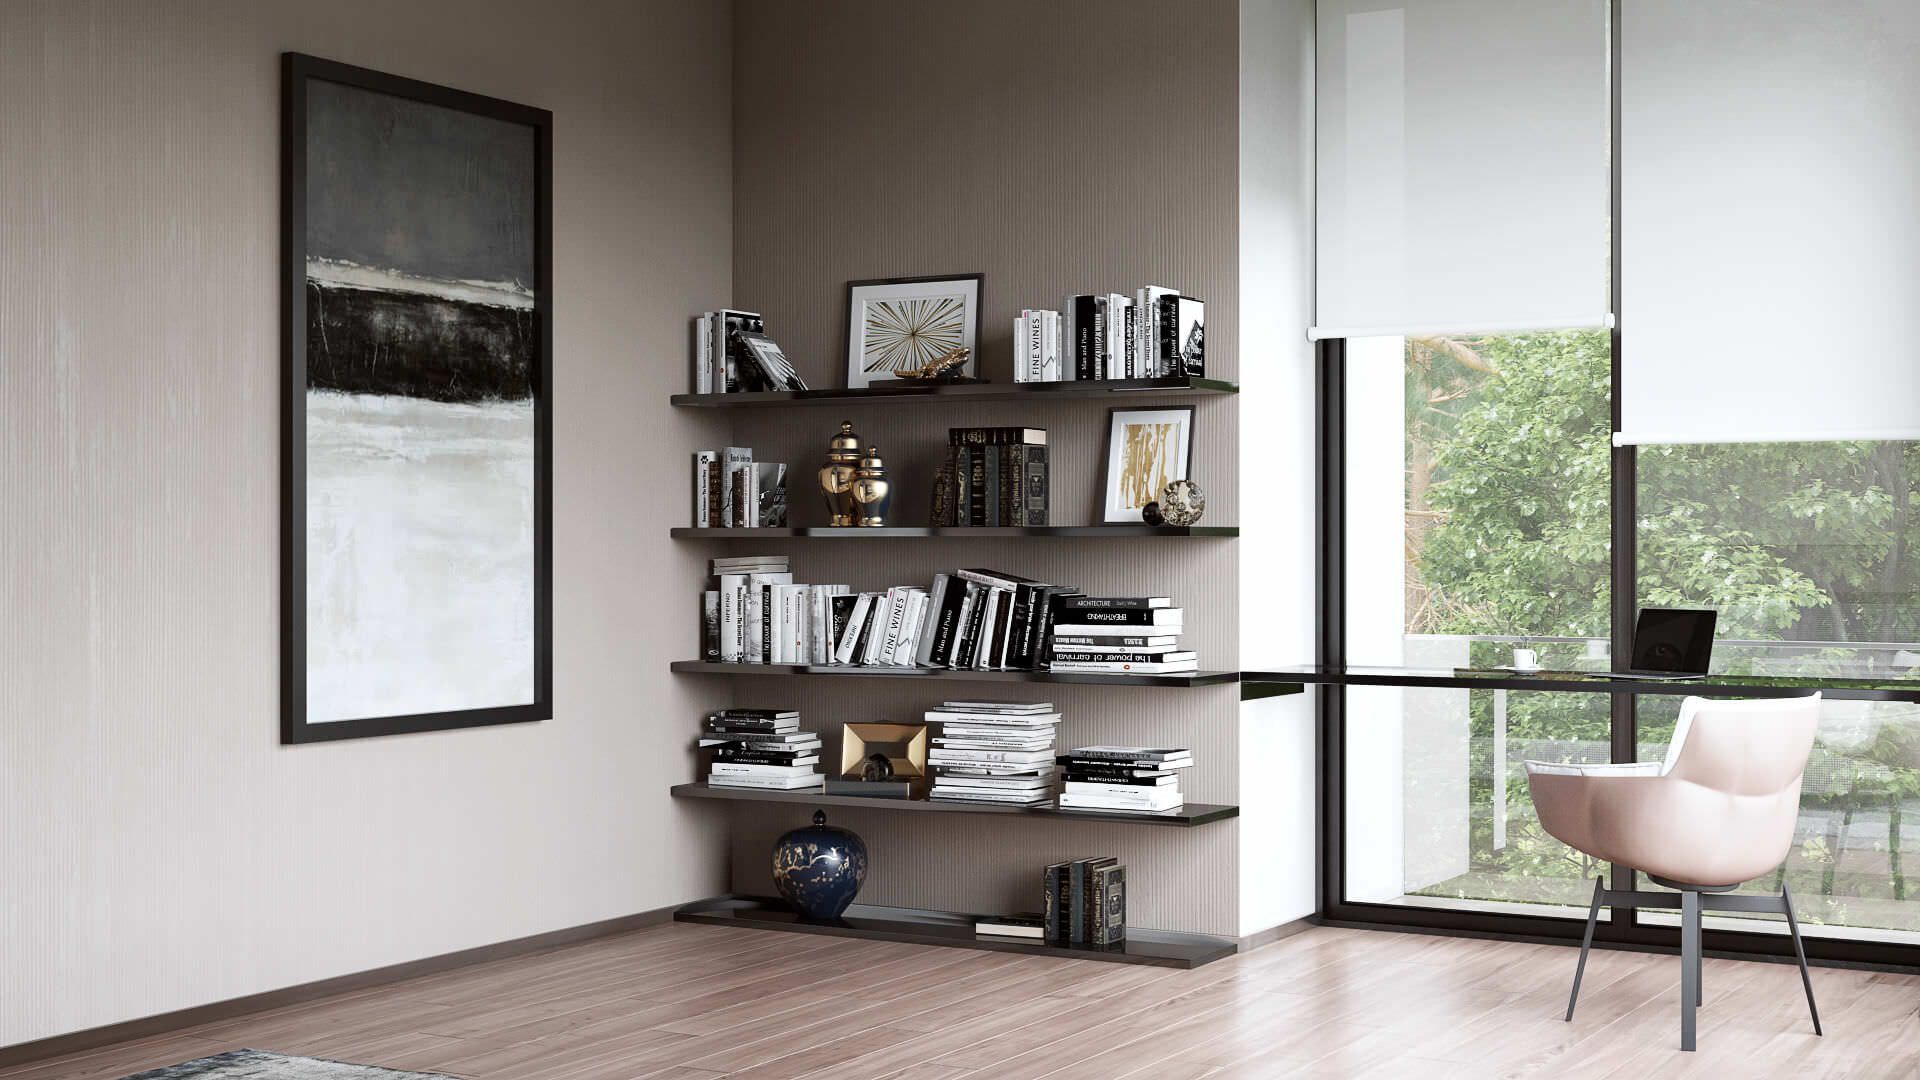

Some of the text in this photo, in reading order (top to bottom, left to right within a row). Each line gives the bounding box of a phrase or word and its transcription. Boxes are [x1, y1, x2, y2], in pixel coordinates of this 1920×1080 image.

[1032, 318, 1040, 375] FINE WINES
[885, 597, 904, 655] FINE WINES
[937, 640, 946, 653] Man
[1056, 653, 1090, 661] carnival
[1093, 653, 1103, 661] of
[1105, 653, 1133, 662] power
